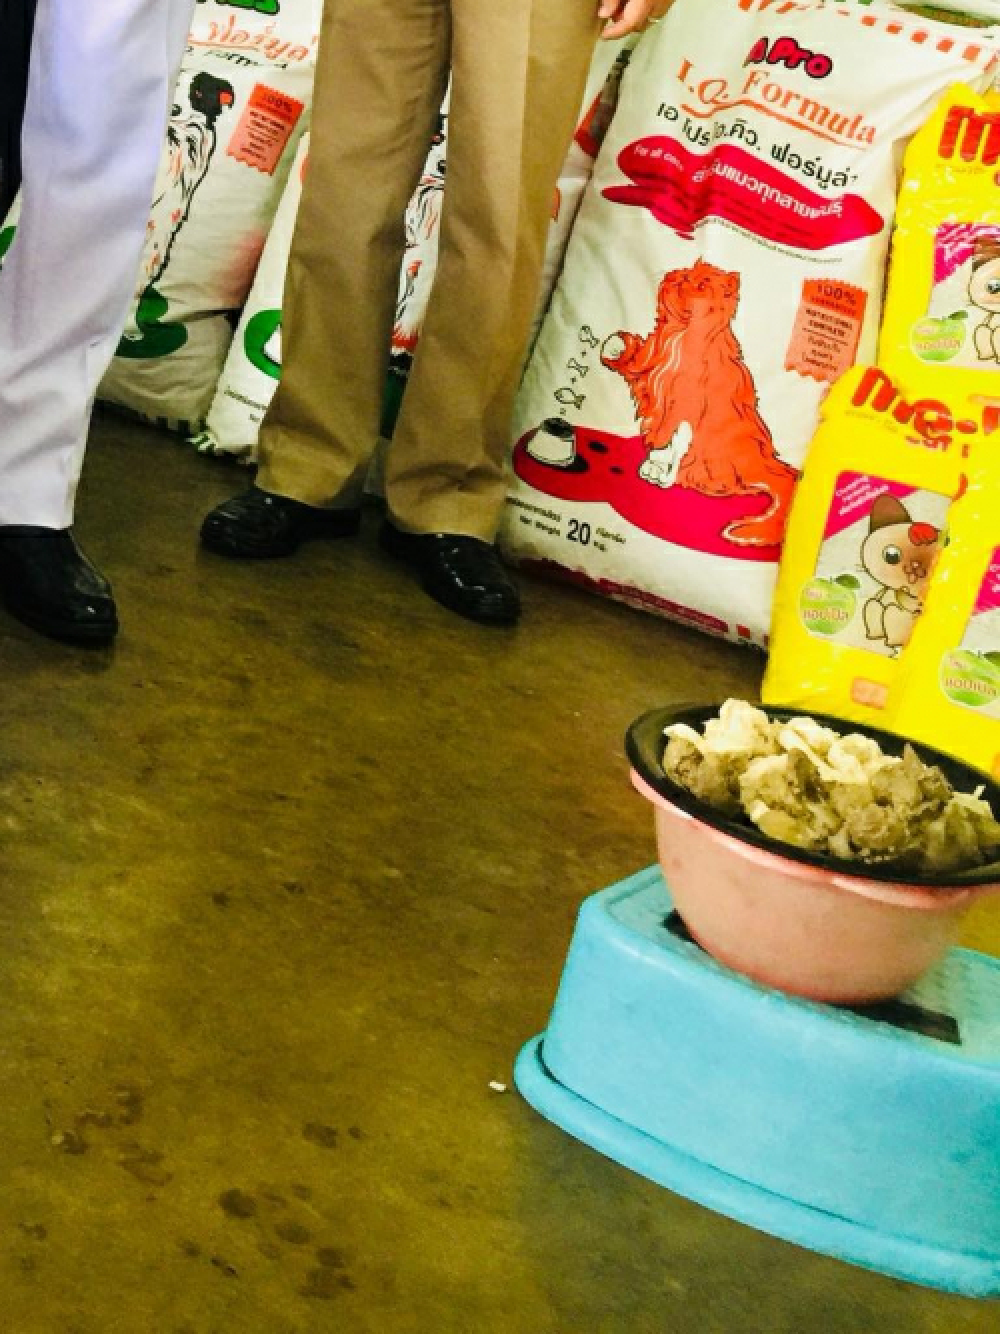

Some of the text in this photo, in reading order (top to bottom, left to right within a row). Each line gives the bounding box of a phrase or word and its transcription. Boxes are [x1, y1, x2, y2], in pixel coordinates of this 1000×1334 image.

[656, 102, 680, 122] เอ
[742, 69, 878, 145] Formula
[567, 519, 590, 545] 20
